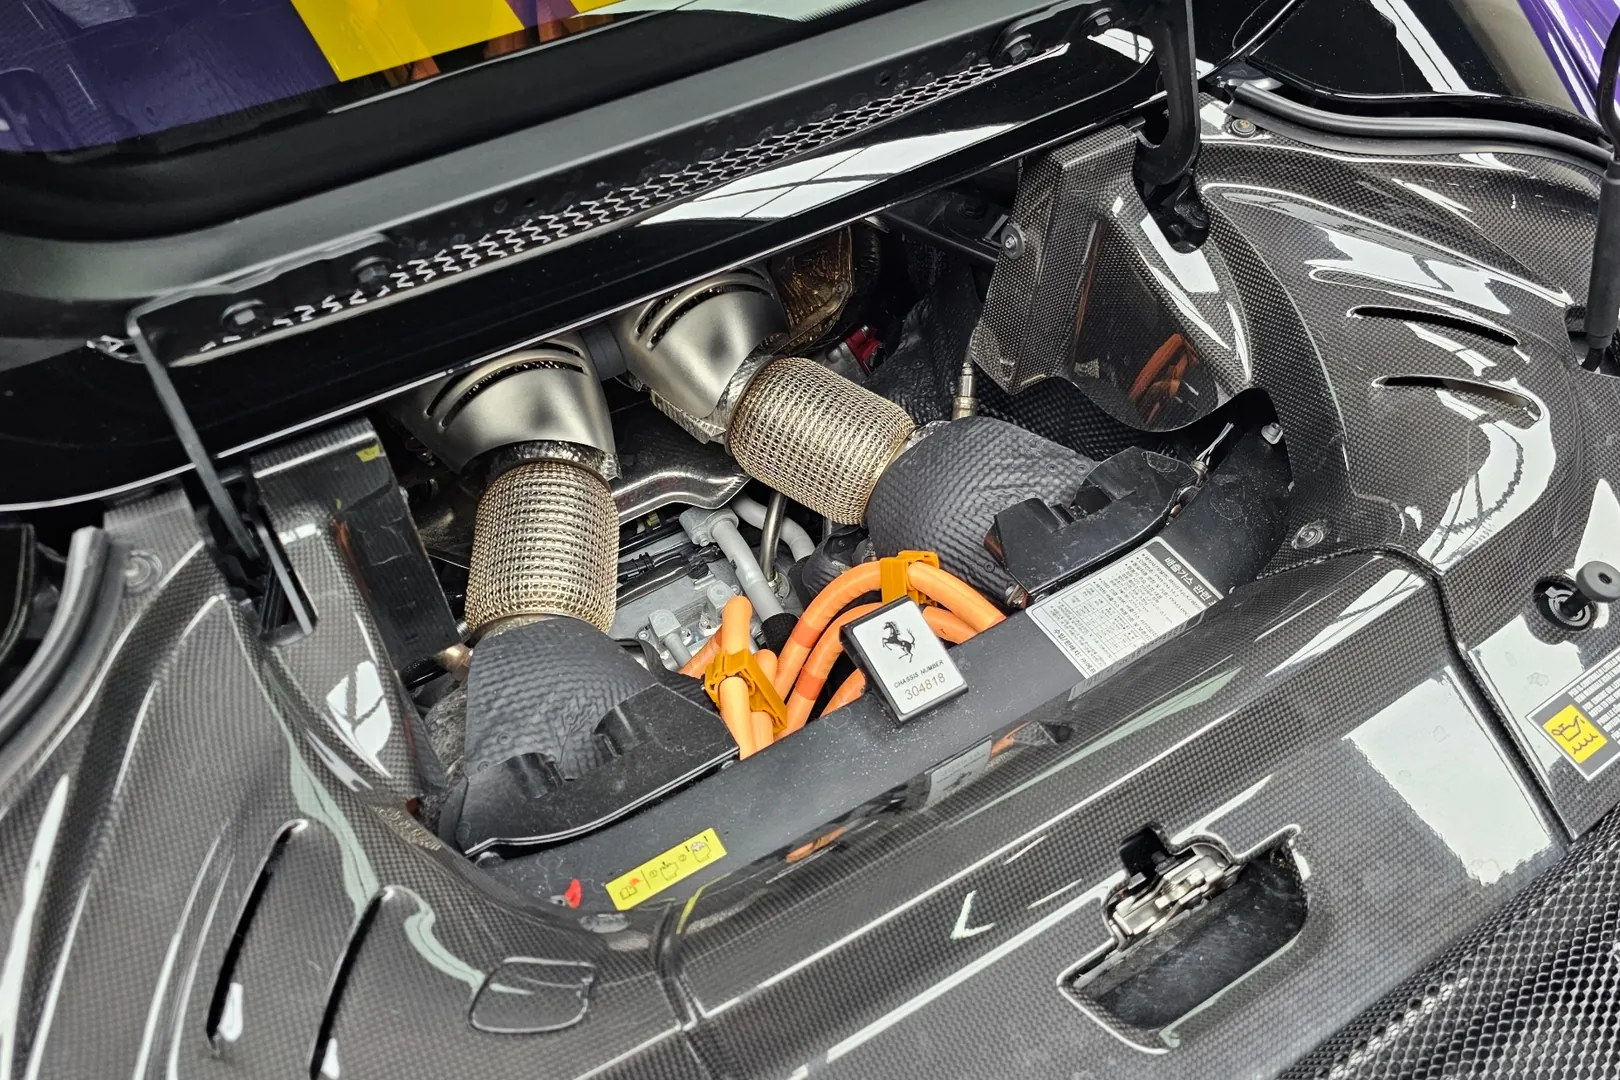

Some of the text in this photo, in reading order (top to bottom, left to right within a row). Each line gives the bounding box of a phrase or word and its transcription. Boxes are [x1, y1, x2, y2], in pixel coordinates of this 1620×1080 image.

[1161, 556, 1197, 586] 배출가스
[1190, 583, 1213, 601] 관련
[894, 659, 944, 688] CHASSIS NUMBER
[905, 673, 946, 700] 304818
